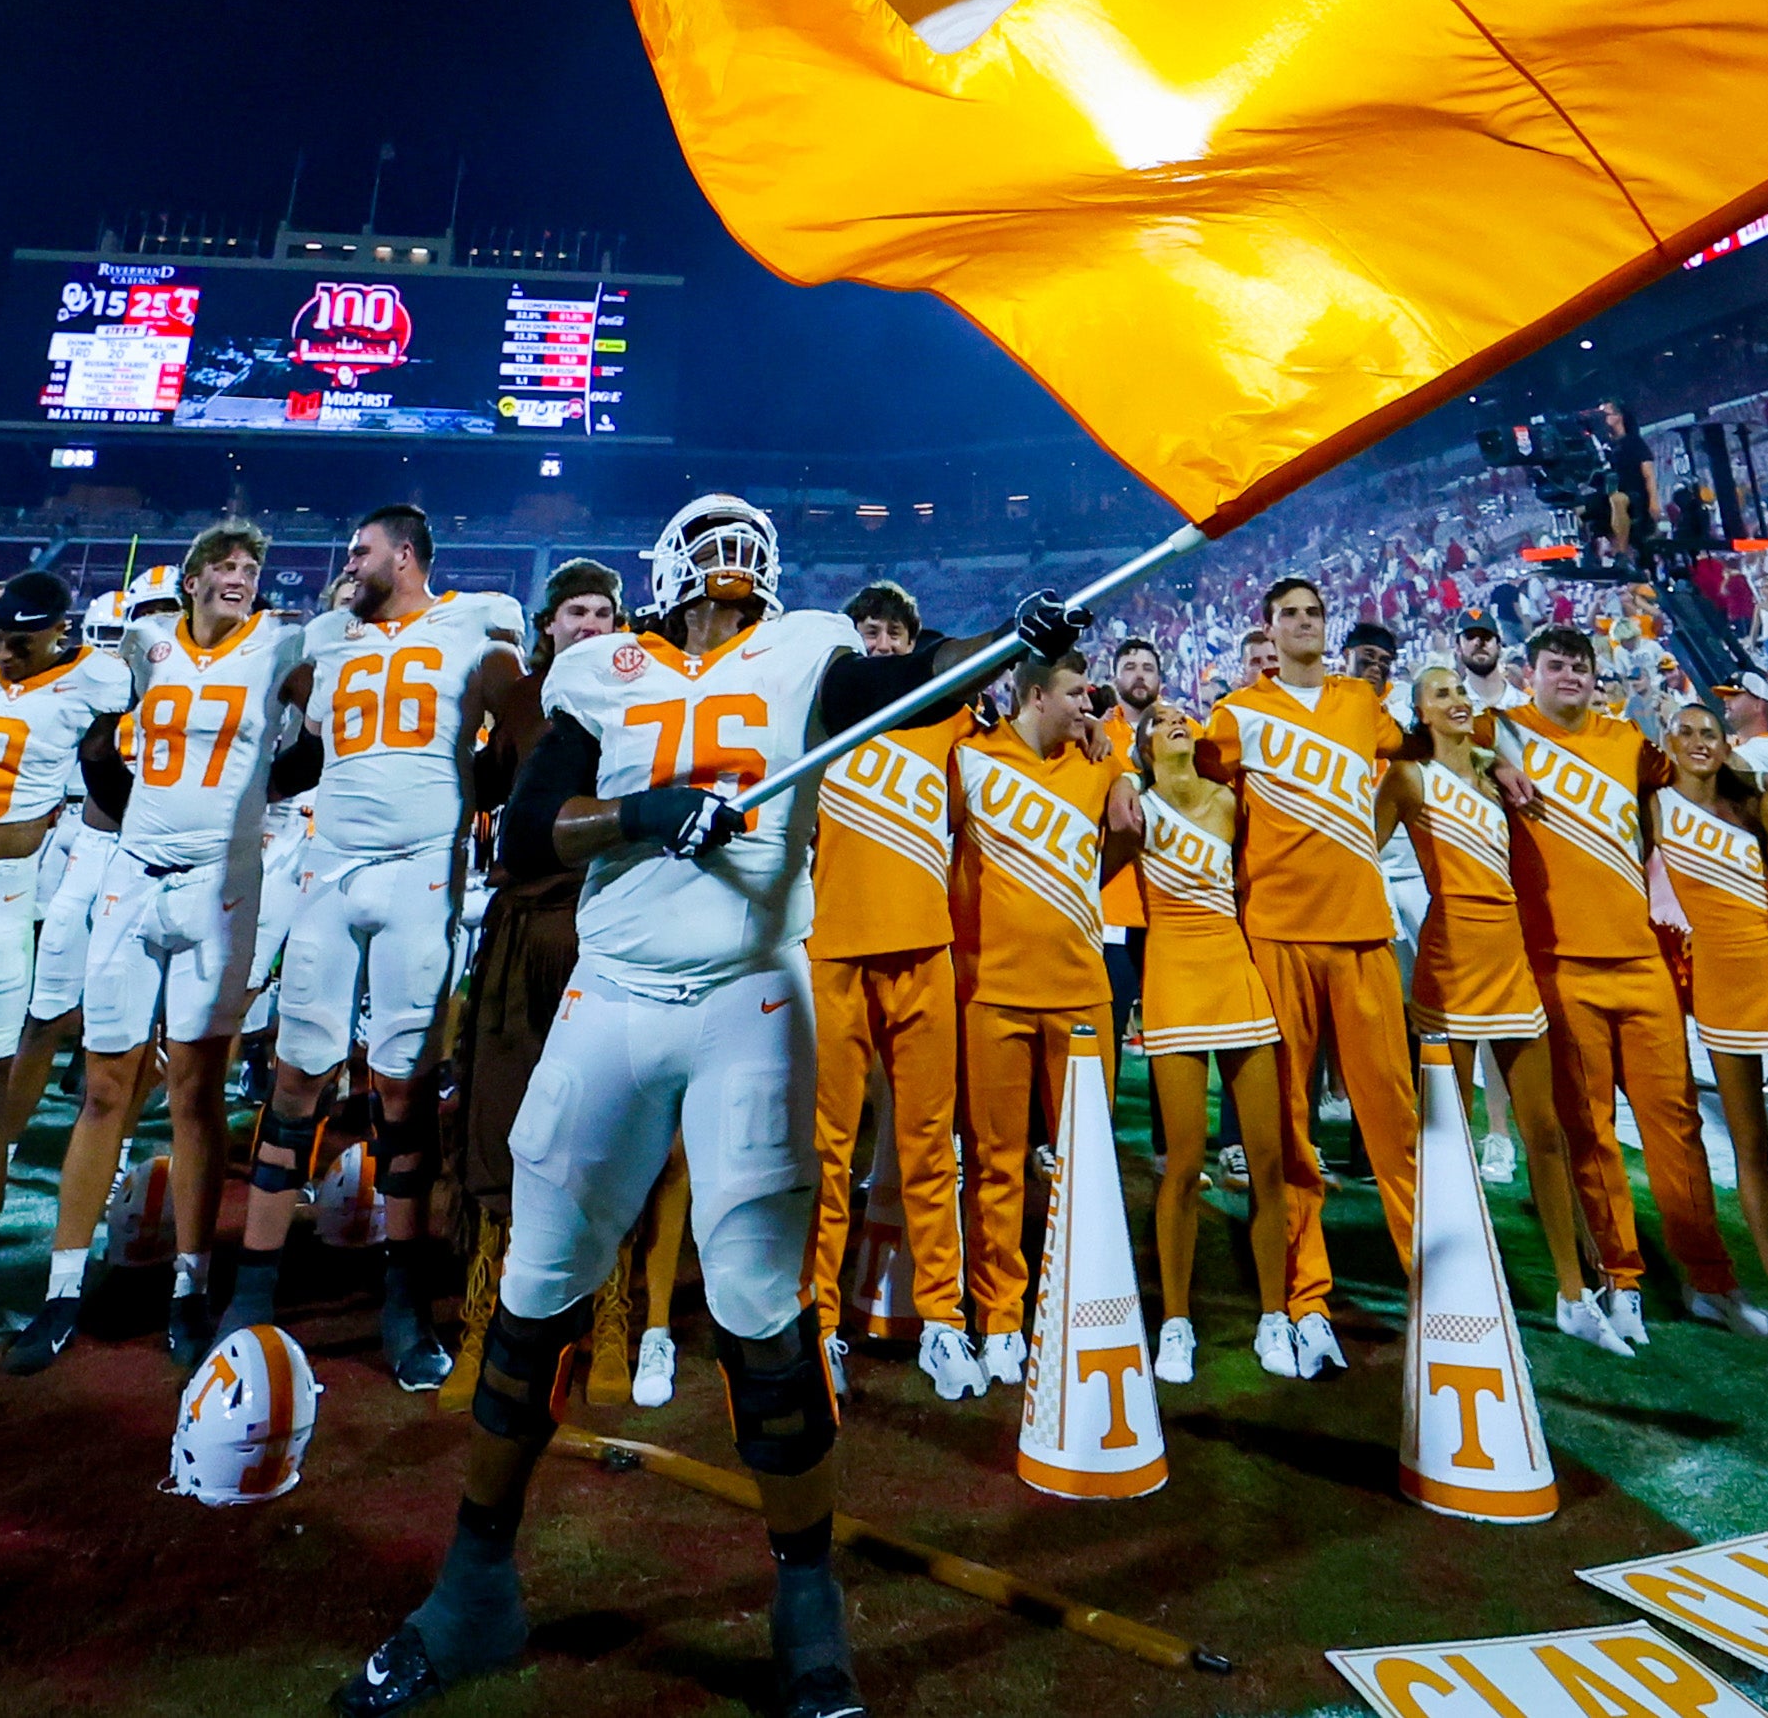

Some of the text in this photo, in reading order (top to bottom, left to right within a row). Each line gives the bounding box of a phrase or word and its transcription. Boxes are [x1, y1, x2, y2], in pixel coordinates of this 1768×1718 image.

[93, 290, 128, 317] 15
[131, 292, 169, 318] 25
[313, 290, 394, 332] 100
[47, 408, 162, 423] MATHIS HOME
[197, 654, 212, 670] T
[387, 621, 401, 637] T
[614, 648, 644, 671] SEC
[9, 684, 24, 700] T
[331, 646, 442, 757] 66
[684, 659, 703, 677] T
[139, 685, 247, 787] 87
[623, 693, 769, 834] 76
[1260, 721, 1373, 817] VOLS
[844, 738, 947, 824] OLS
[1433, 771, 1510, 849] VOLS
[1521, 737, 1640, 843] VOLS
[980, 766, 1098, 883] VOLS
[1154, 816, 1233, 885] VOLS
[1670, 806, 1763, 875] VOLS
[561, 990, 584, 1021] T
[186, 1353, 235, 1421] T
[1076, 1345, 1144, 1450] T
[1429, 1362, 1505, 1471] T
